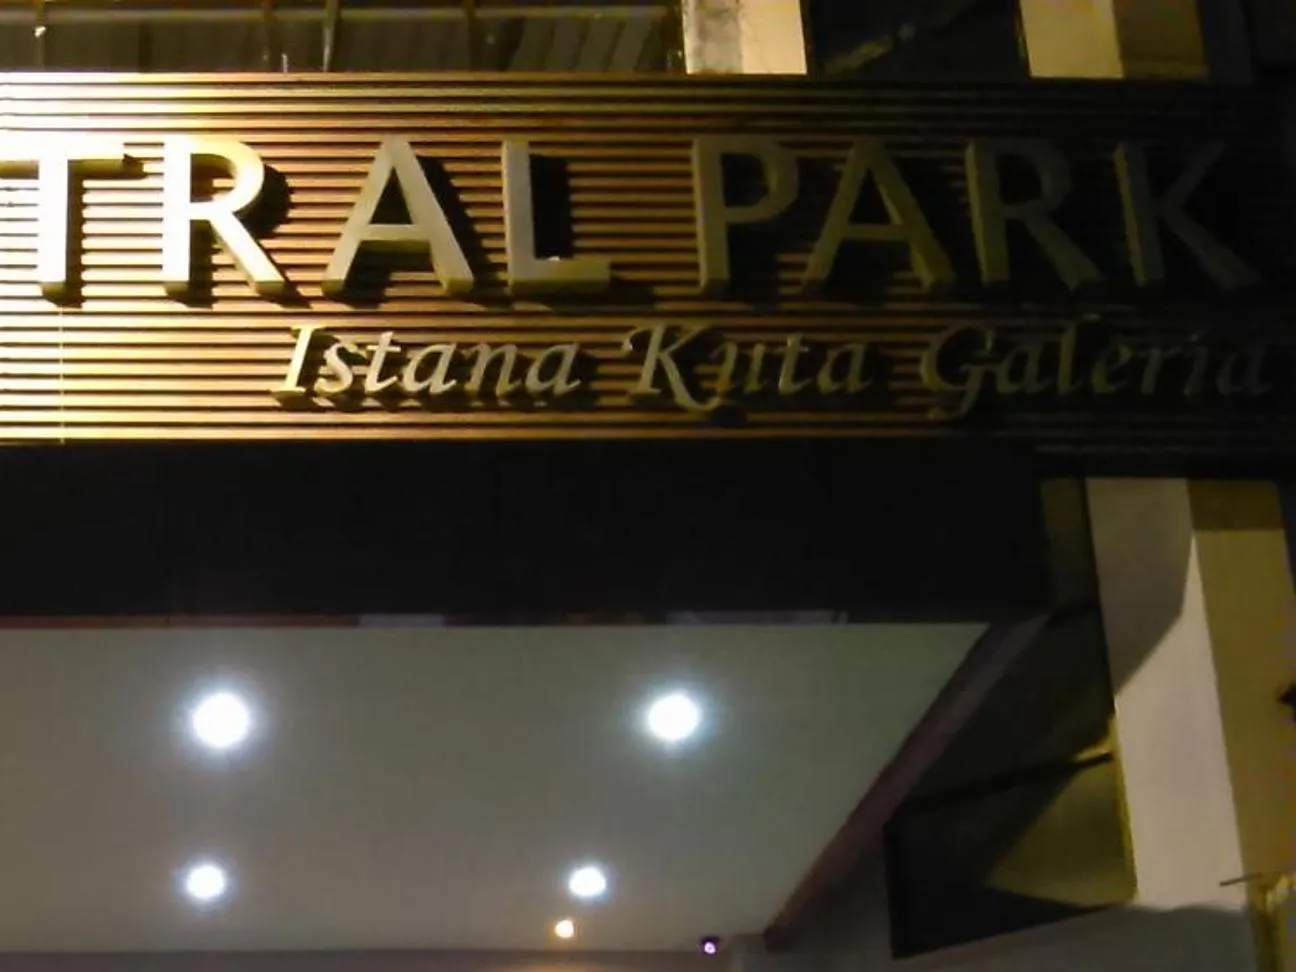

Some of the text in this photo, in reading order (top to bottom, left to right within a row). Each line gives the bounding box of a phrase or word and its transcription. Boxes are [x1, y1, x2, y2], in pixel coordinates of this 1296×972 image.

[689, 137, 1264, 292] PARK
[274, 313, 1274, 420] Istana Kuta Galeria
